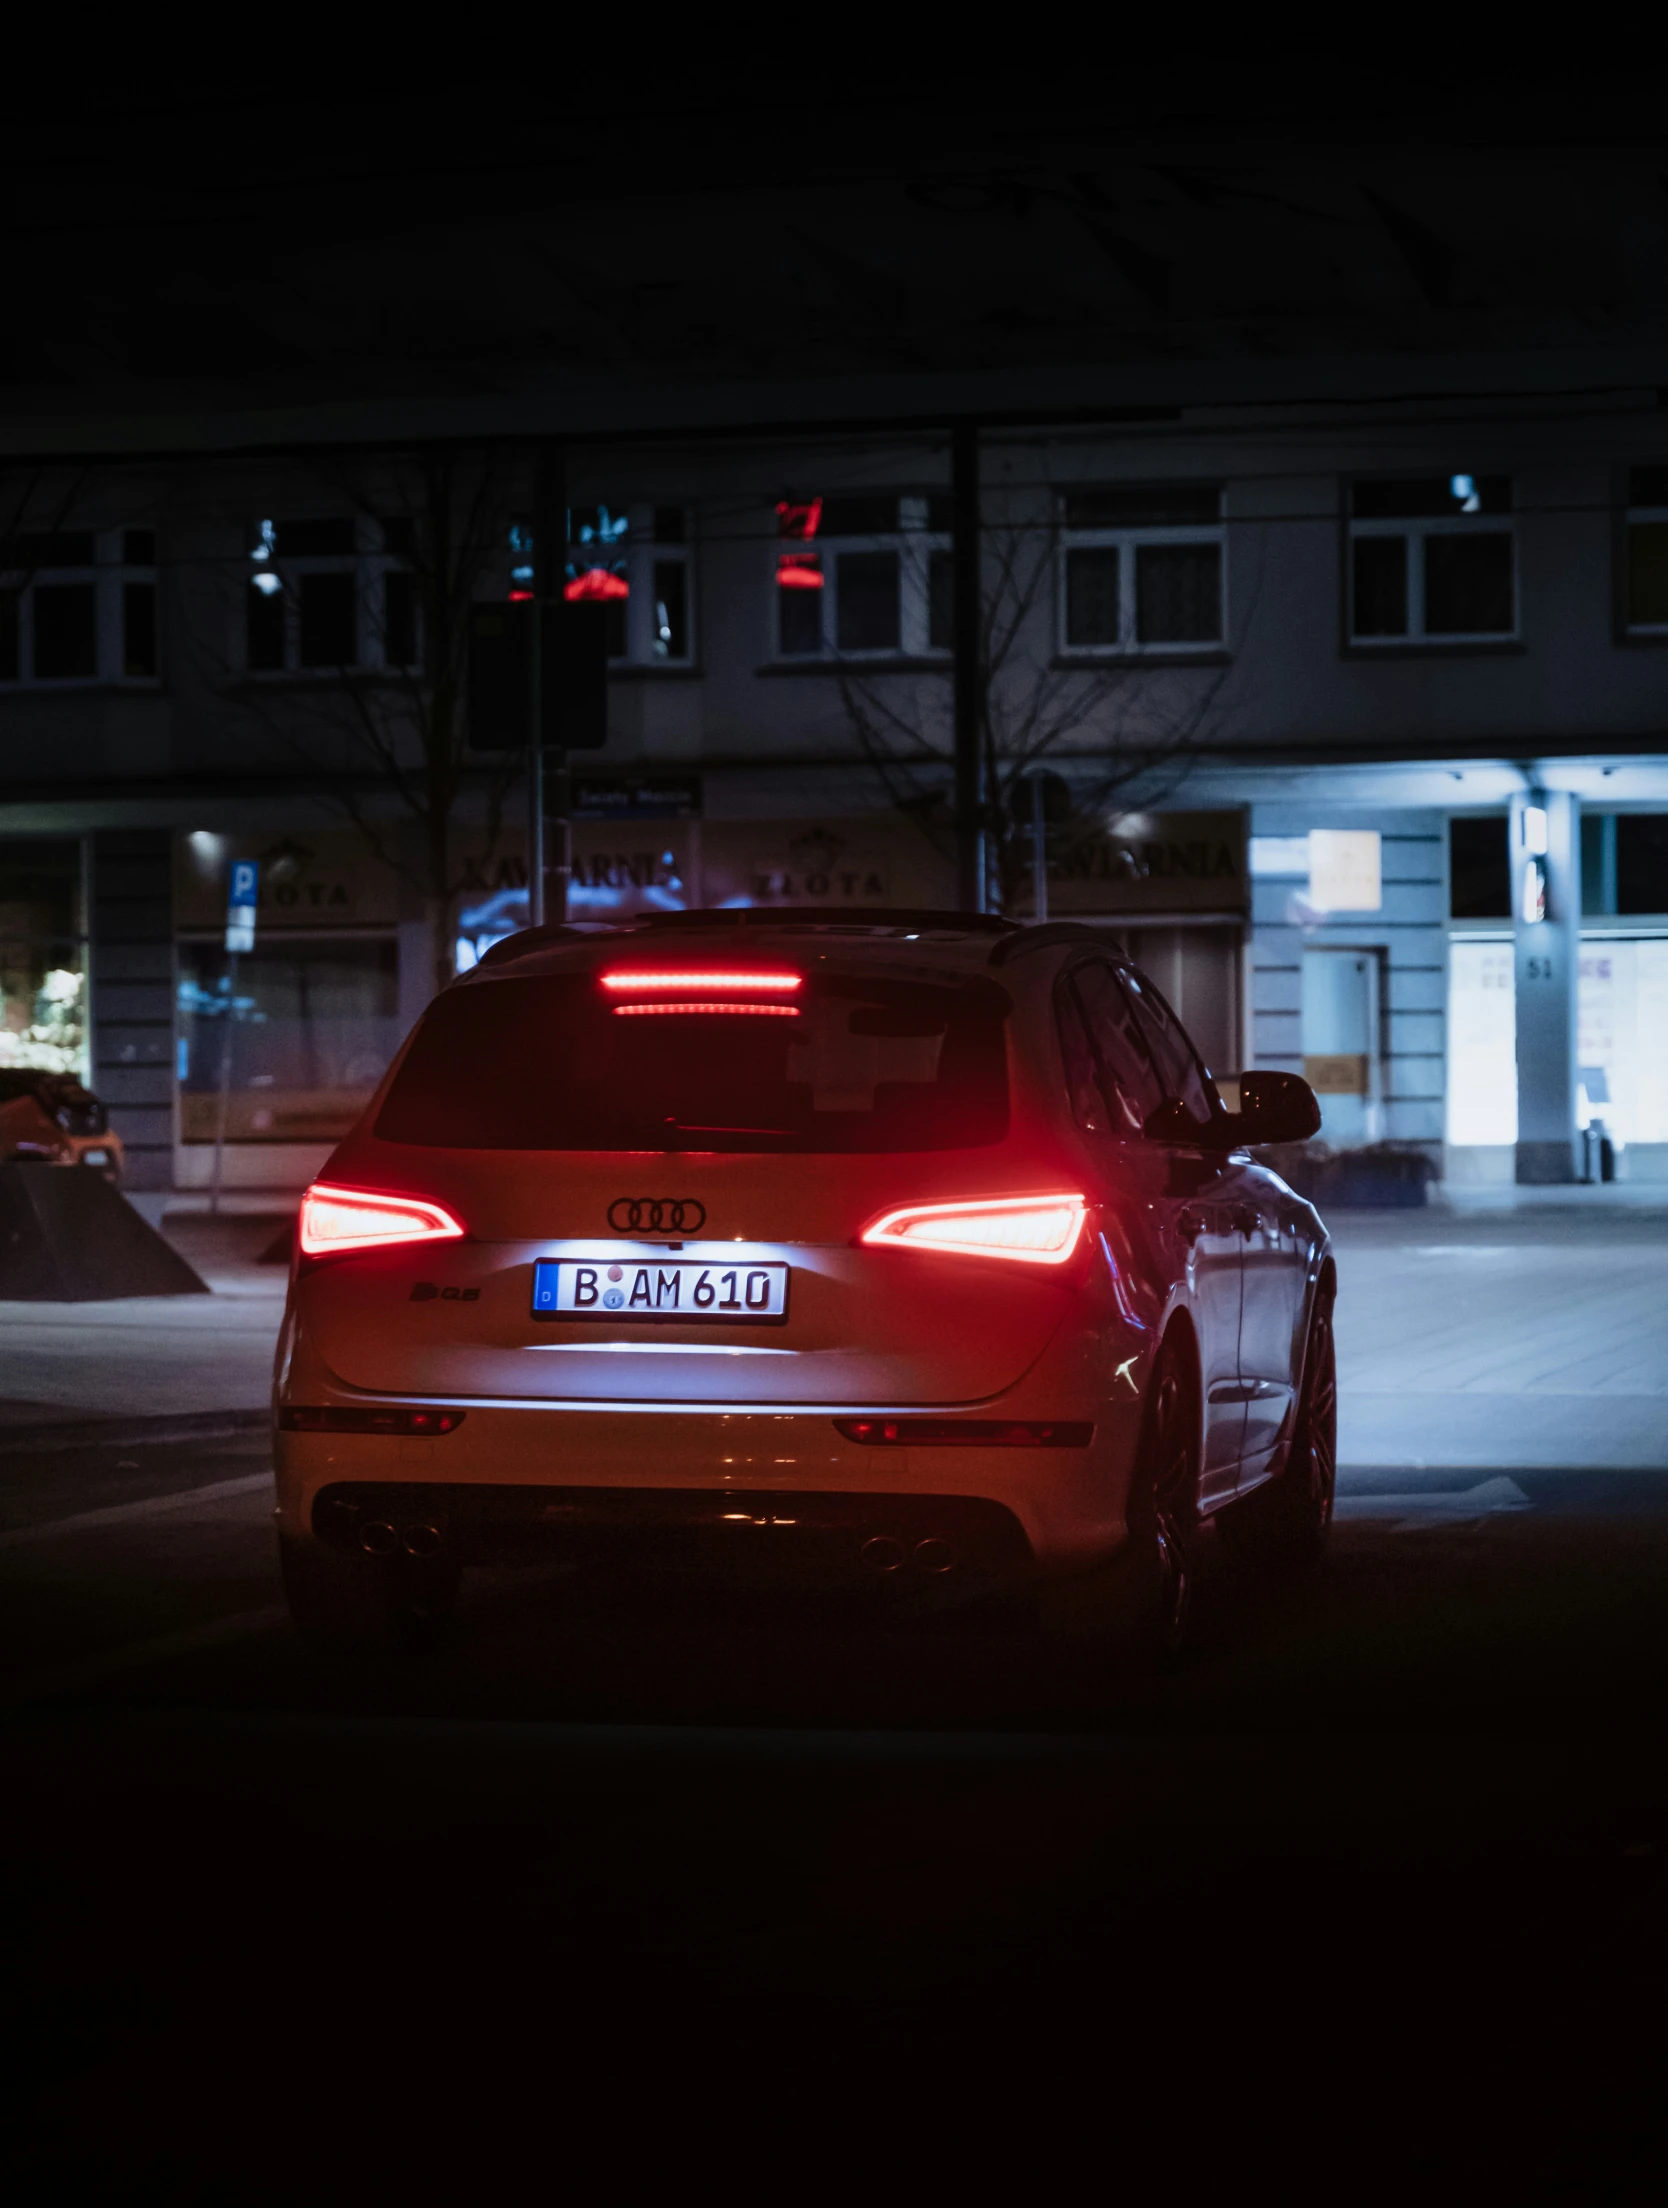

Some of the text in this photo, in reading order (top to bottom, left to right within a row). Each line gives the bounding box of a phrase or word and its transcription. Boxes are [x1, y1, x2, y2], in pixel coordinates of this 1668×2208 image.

[234, 864, 255, 899] P
[541, 1291, 551, 1302] D
[574, 1268, 770, 1310] B AM 610
